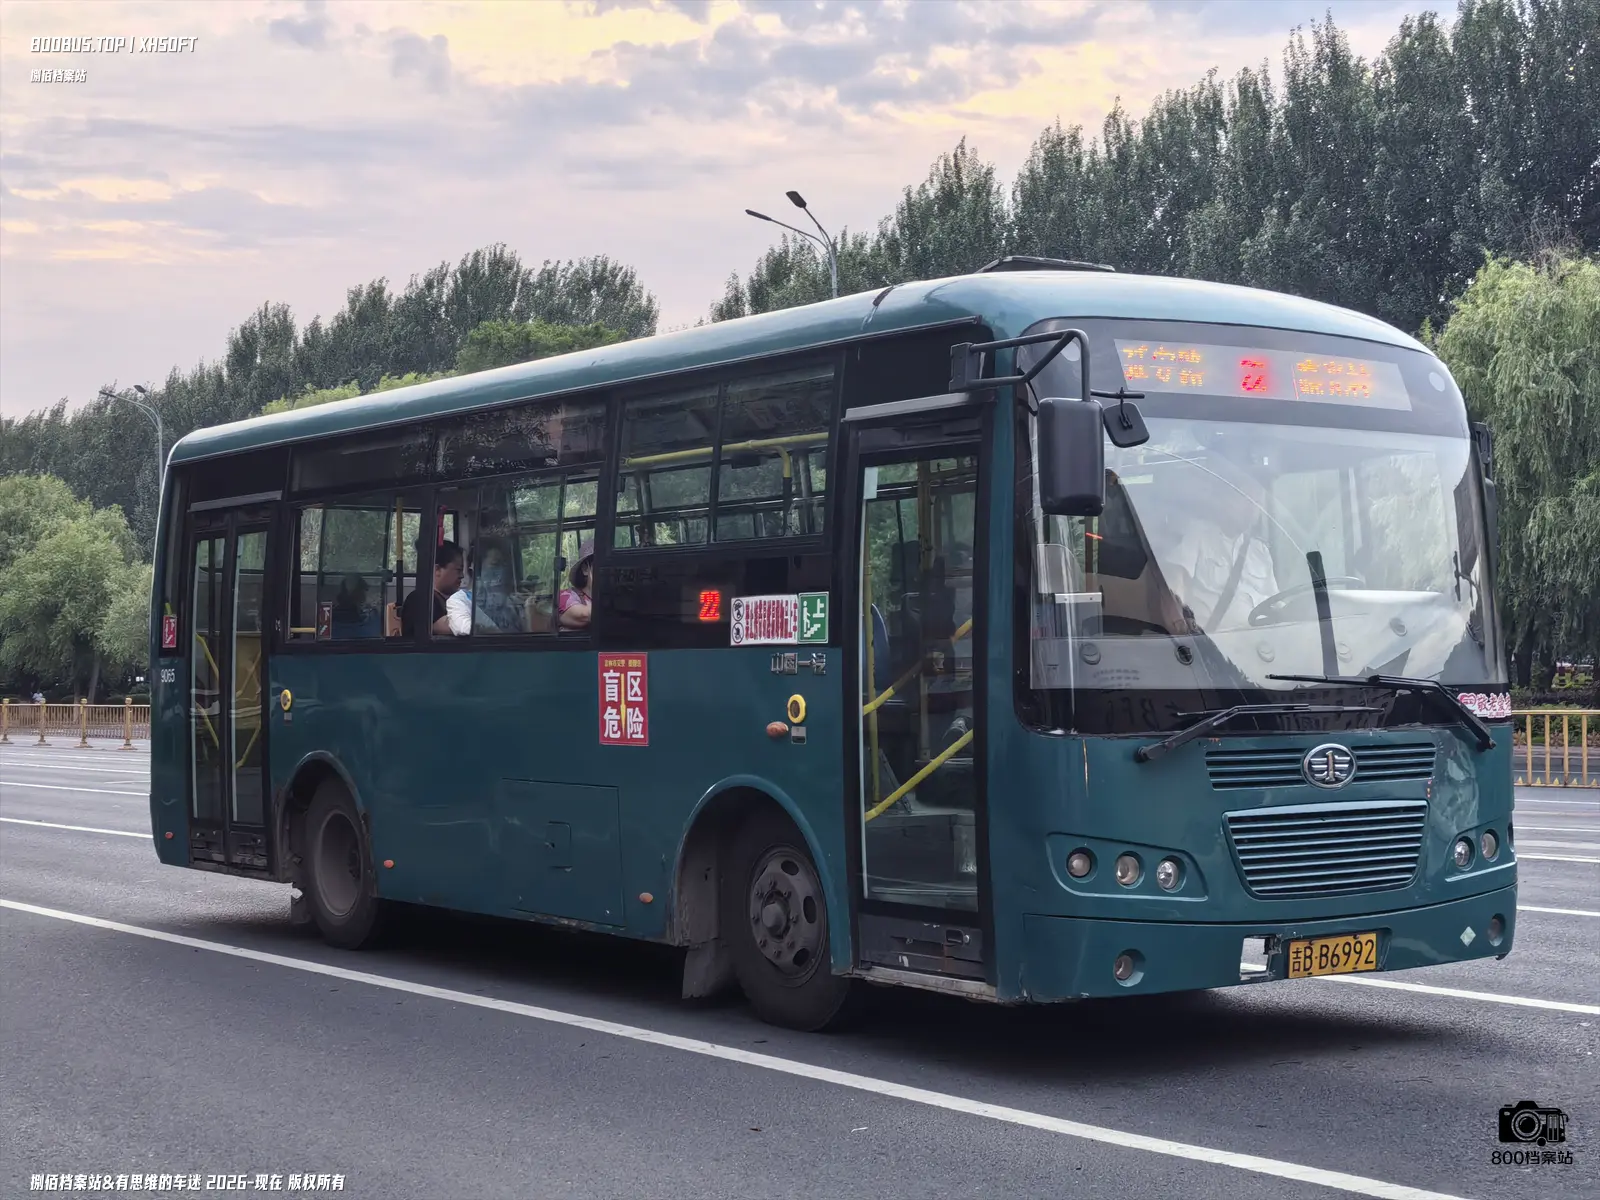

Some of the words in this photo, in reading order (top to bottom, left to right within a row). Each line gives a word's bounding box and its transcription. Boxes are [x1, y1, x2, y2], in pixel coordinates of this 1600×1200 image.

[812, 598, 825, 618] 上
[160, 668, 175, 683] 9065
[602, 669, 644, 702] 盲区
[602, 705, 645, 739] 危险
